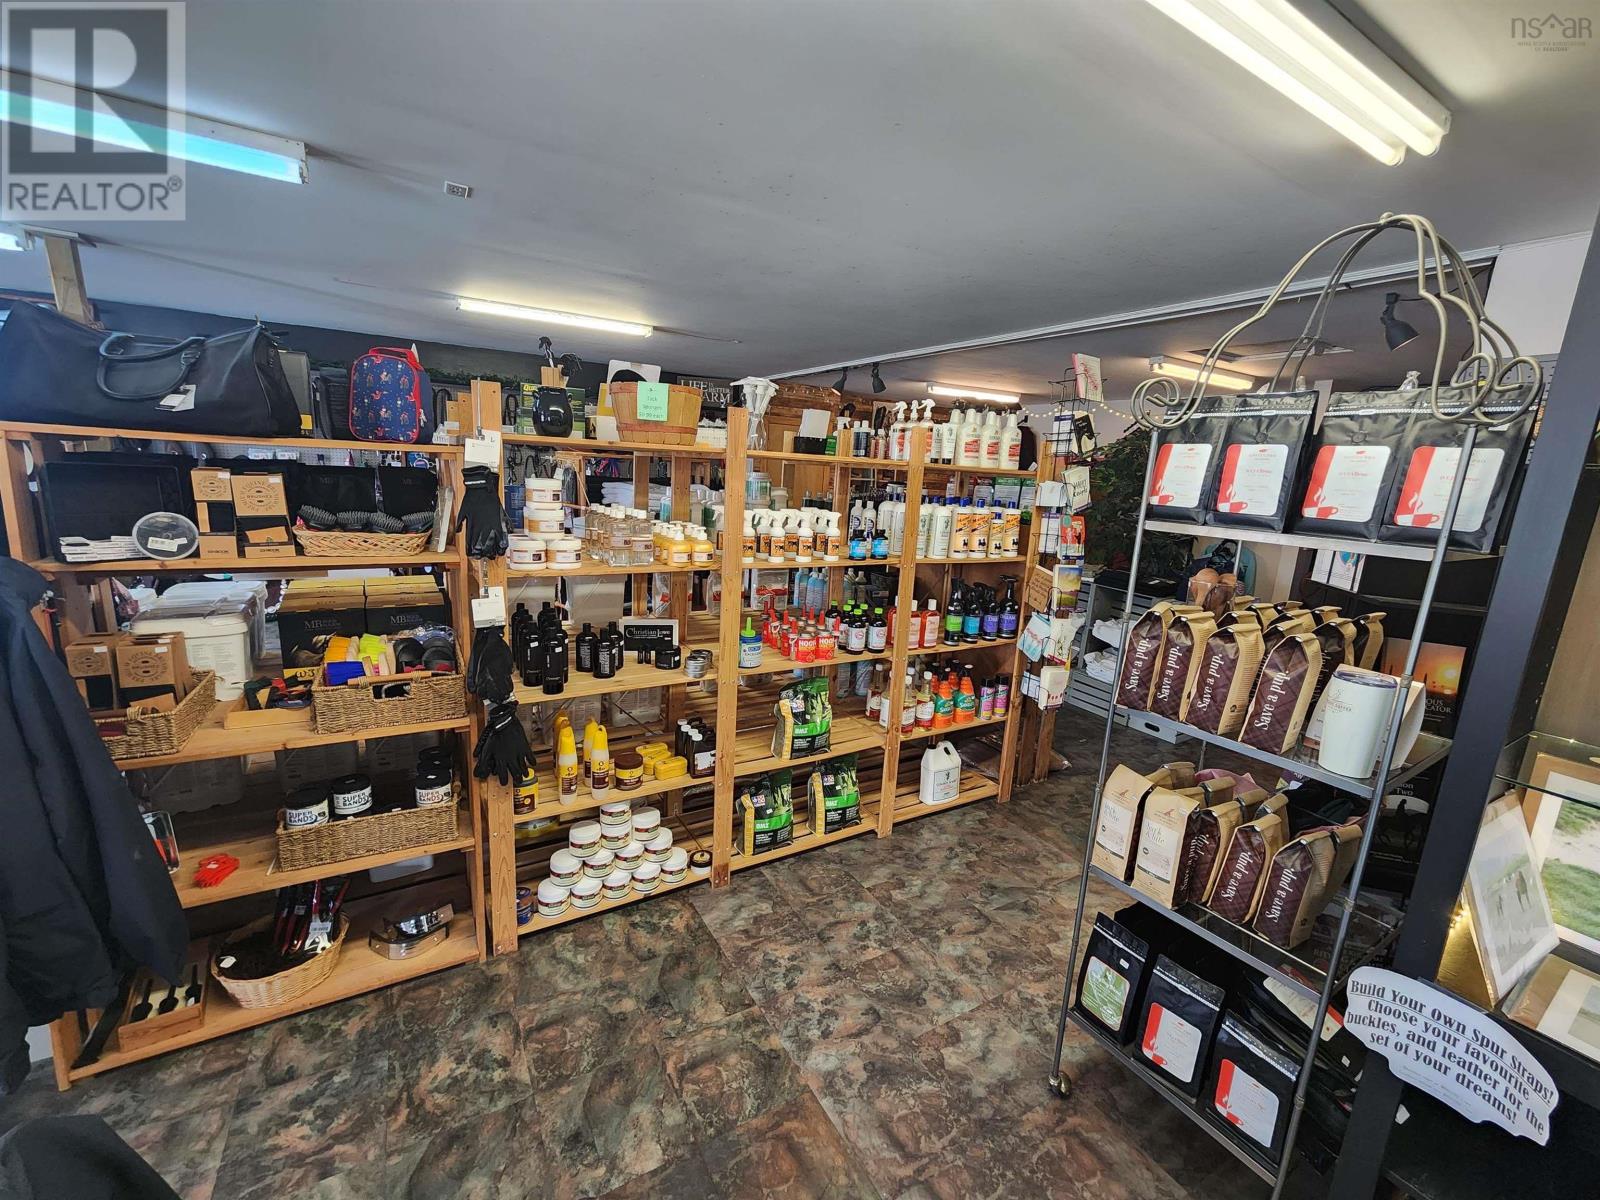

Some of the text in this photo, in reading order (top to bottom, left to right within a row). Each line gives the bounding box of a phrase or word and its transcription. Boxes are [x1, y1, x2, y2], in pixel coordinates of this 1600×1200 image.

[701, 392, 730, 403] ARM
[625, 627, 657, 638] Christian
[1125, 637, 1151, 692] Save a pup.
[1157, 675, 1173, 702] Save
[1168, 645, 1183, 671] pup.
[1196, 653, 1223, 712] Save a pup.
[1270, 670, 1291, 695] pup.
[1267, 694, 1279, 703] a
[1425, 698, 1444, 706] OUS
[1425, 705, 1453, 713] CATOR
[1254, 704, 1275, 731] Save
[342, 793, 366, 803] SUPER
[342, 797, 367, 807] BANDS
[288, 810, 313, 820] SUPER
[288, 814, 314, 824] BANDS
[1220, 850, 1252, 902] Save a pup.
[1265, 867, 1295, 923] Save a pup.
[1350, 980, 1554, 1105] Build Your Own Spur Straps!
[1368, 999, 1418, 1027] Choose
[1423, 1020, 1460, 1047] your
[1464, 1039, 1530, 1101] favourite
[1347, 1012, 1400, 1037] buckles,
[1406, 1029, 1437, 1053] and
[1442, 1045, 1500, 1090] leather
[1503, 1086, 1523, 1111] for
[1526, 1107, 1545, 1136] the
[1370, 1032, 1389, 1047] set
[1394, 1037, 1409, 1056] of
[1413, 1049, 1451, 1077] your
[1455, 1068, 1518, 1125] dreams!
